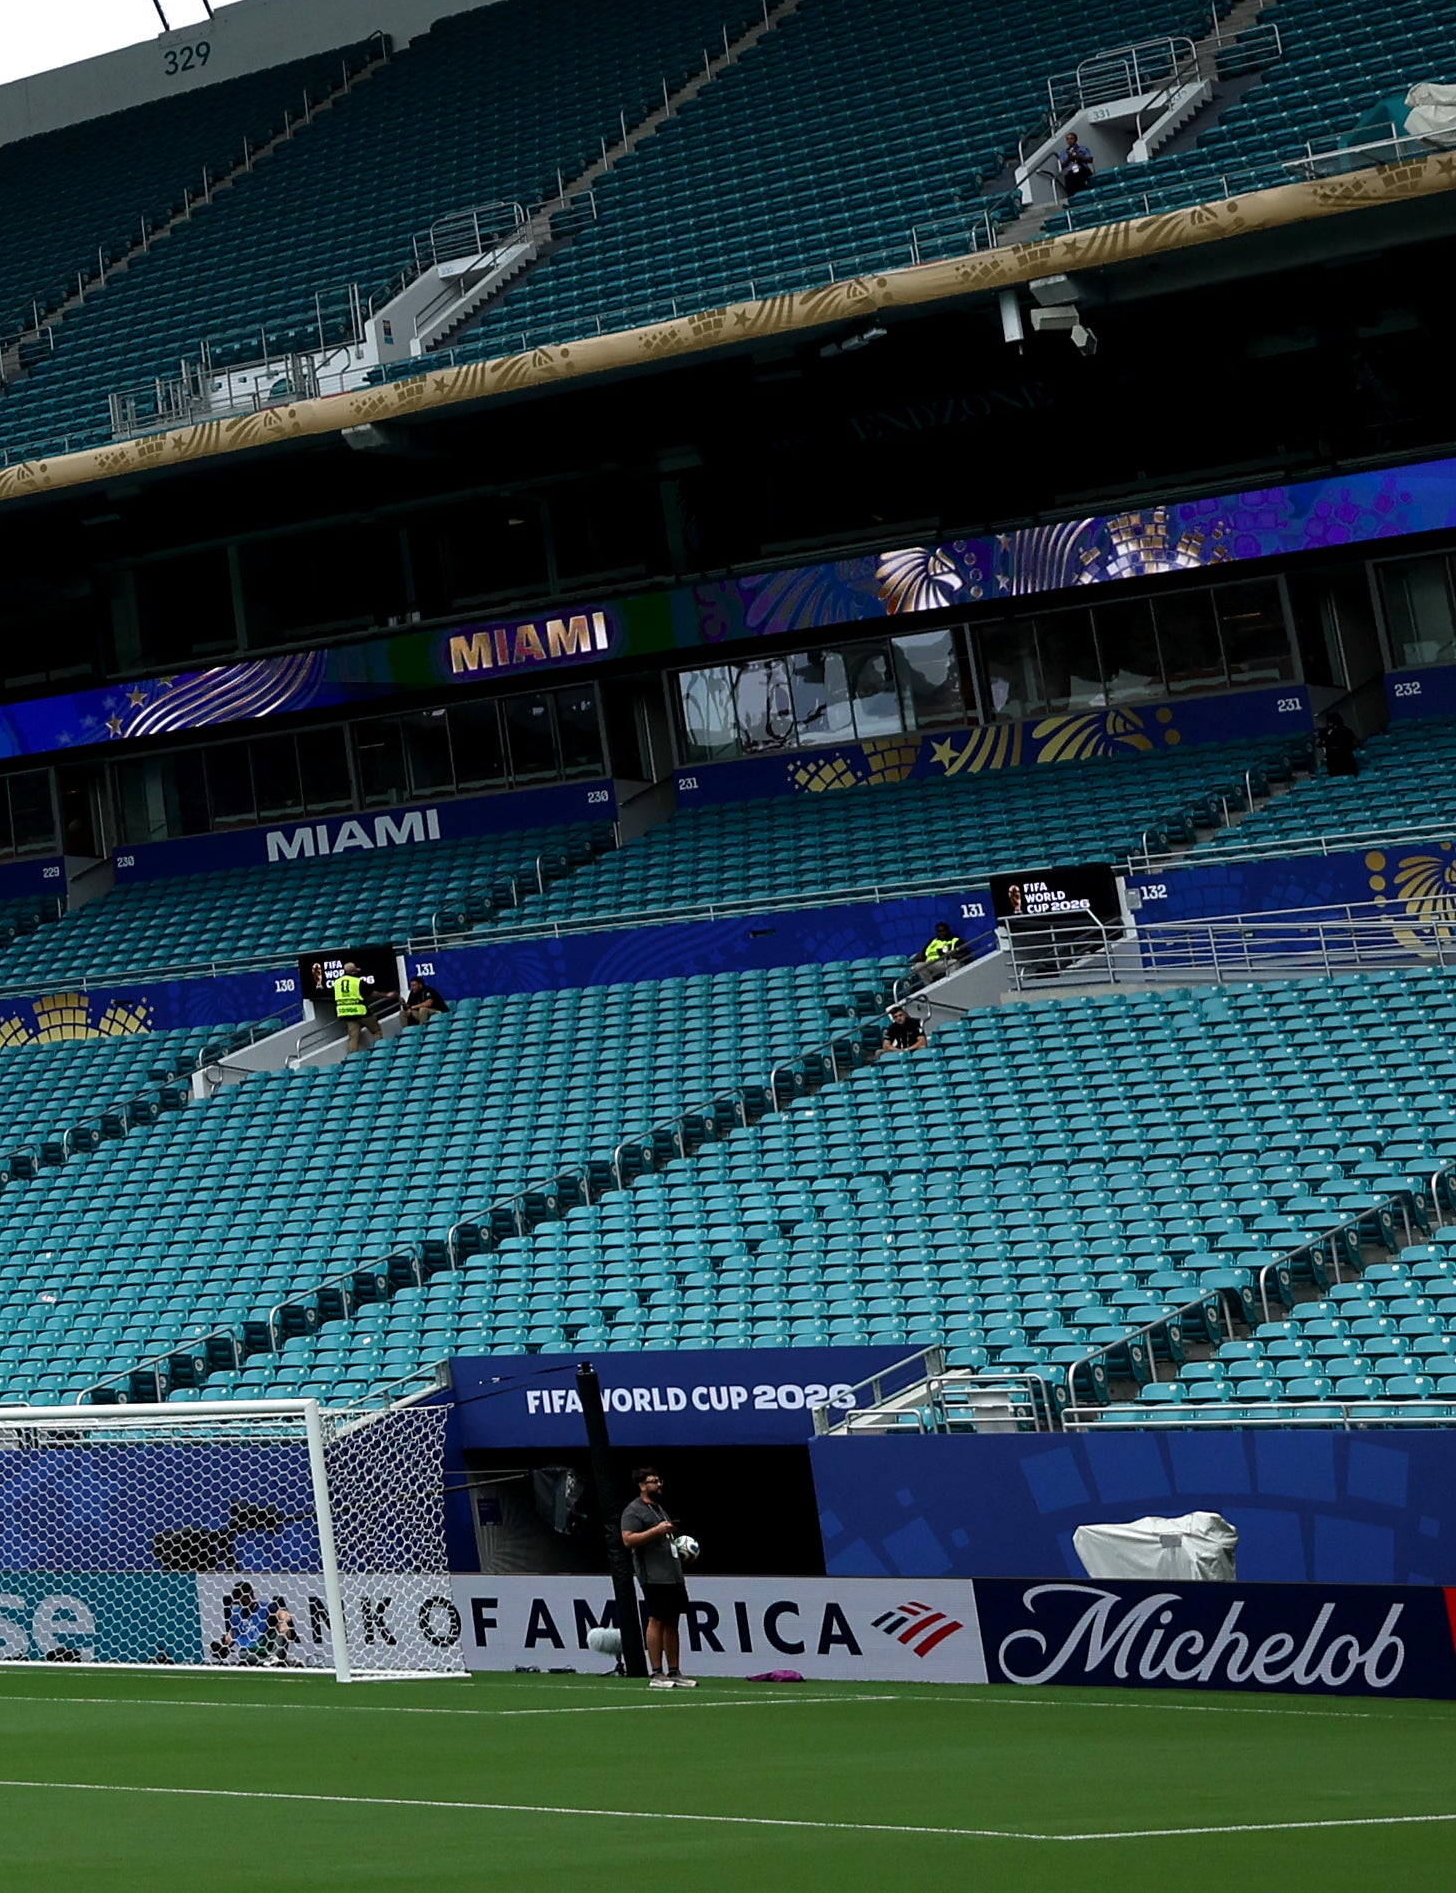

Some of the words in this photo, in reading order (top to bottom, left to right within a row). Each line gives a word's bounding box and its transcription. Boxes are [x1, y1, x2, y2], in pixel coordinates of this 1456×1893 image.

[164, 42, 211, 75] 329
[449, 612, 608, 674] MIAMI
[1394, 681, 1422, 697] 232
[1277, 697, 1302, 713] 231
[678, 777, 699, 791] 231
[587, 790, 610, 804] 230
[266, 808, 441, 863] MIAMI
[116, 855, 135, 868] 230
[42, 865, 60, 879] 229
[1023, 881, 1048, 893] FIFA
[1140, 884, 1168, 900] 132
[1025, 890, 1066, 903] WORLD
[961, 903, 985, 918] 131
[1027, 902, 1050, 914] CUP
[1051, 898, 1091, 911] 2026
[324, 960, 343, 970] FIFA
[415, 963, 436, 976] 131
[274, 979, 295, 992] 130
[526, 1388, 584, 1414] FIFA
[691, 1385, 748, 1411] CUP
[752, 1384, 857, 1411] 2026
[418, 1596, 498, 1648] OF
[525, 1599, 863, 1656] AMRICA
[998, 1583, 1405, 1688] Michelob
